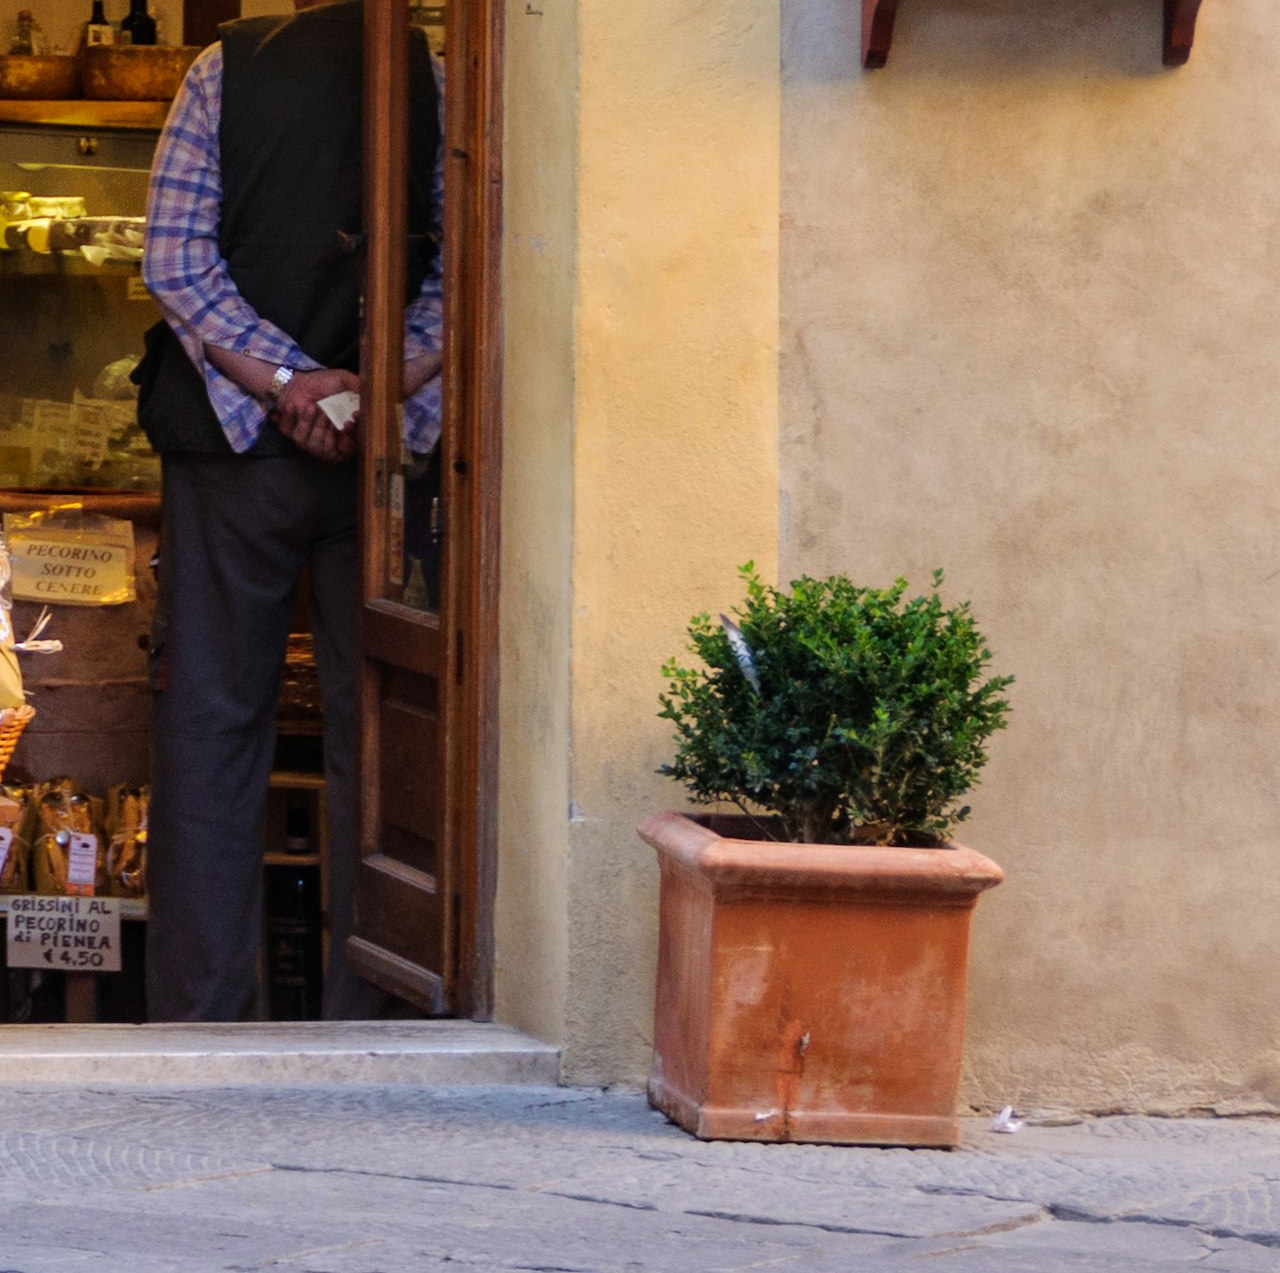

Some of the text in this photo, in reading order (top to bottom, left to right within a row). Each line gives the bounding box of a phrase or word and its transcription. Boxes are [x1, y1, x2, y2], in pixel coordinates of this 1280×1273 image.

[26, 544, 113, 563] PECORINO
[42, 562, 96, 579] SOTTO
[35, 581, 103, 596] CENERE
[88, 901, 111, 915] AL
[14, 930, 31, 943] di
